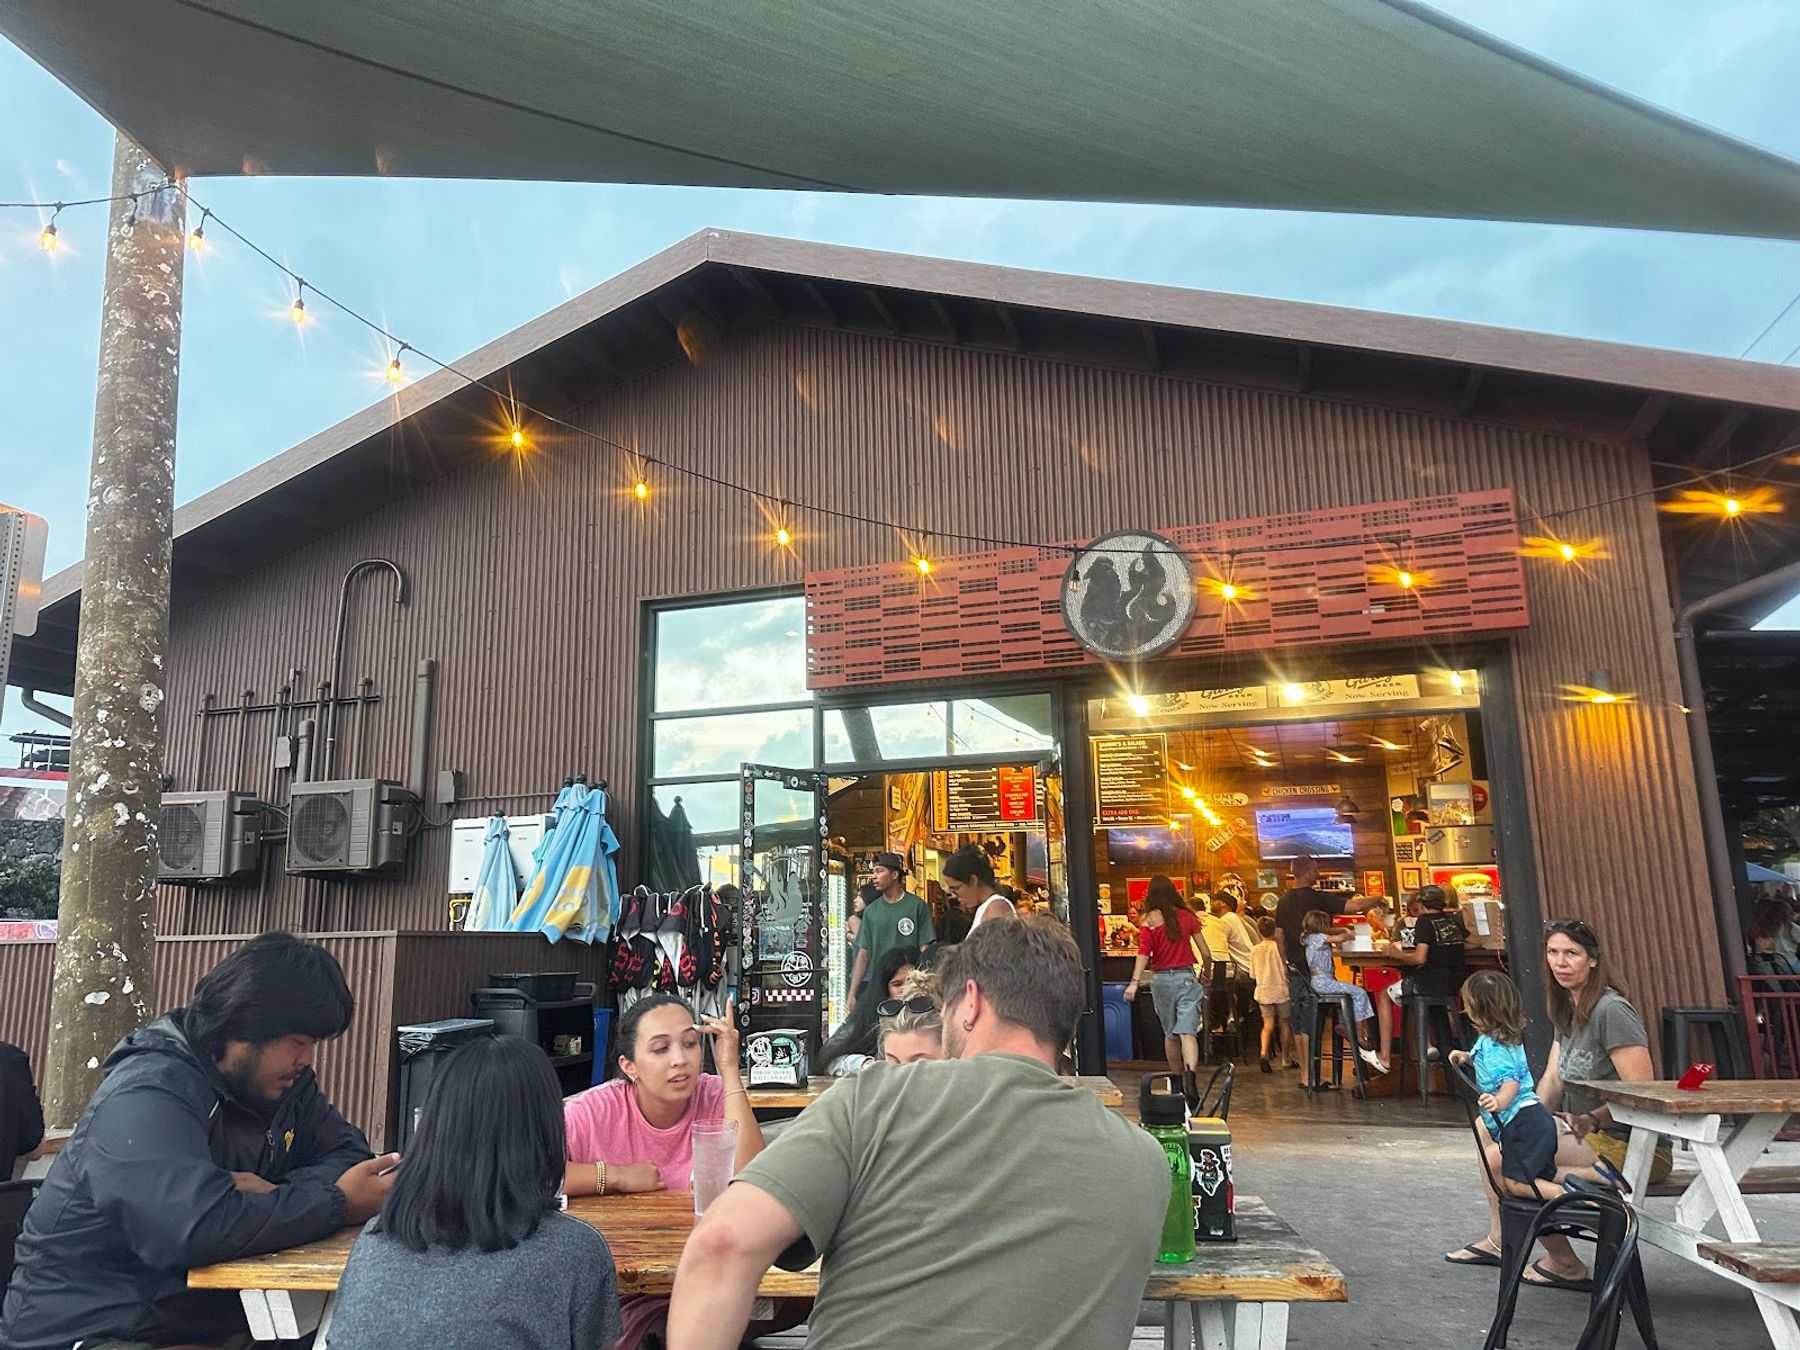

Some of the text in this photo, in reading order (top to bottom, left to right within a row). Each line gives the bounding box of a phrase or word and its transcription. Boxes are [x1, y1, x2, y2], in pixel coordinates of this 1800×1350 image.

[1370, 689, 1409, 698] Serving
[1199, 699, 1258, 710] Now Serving
